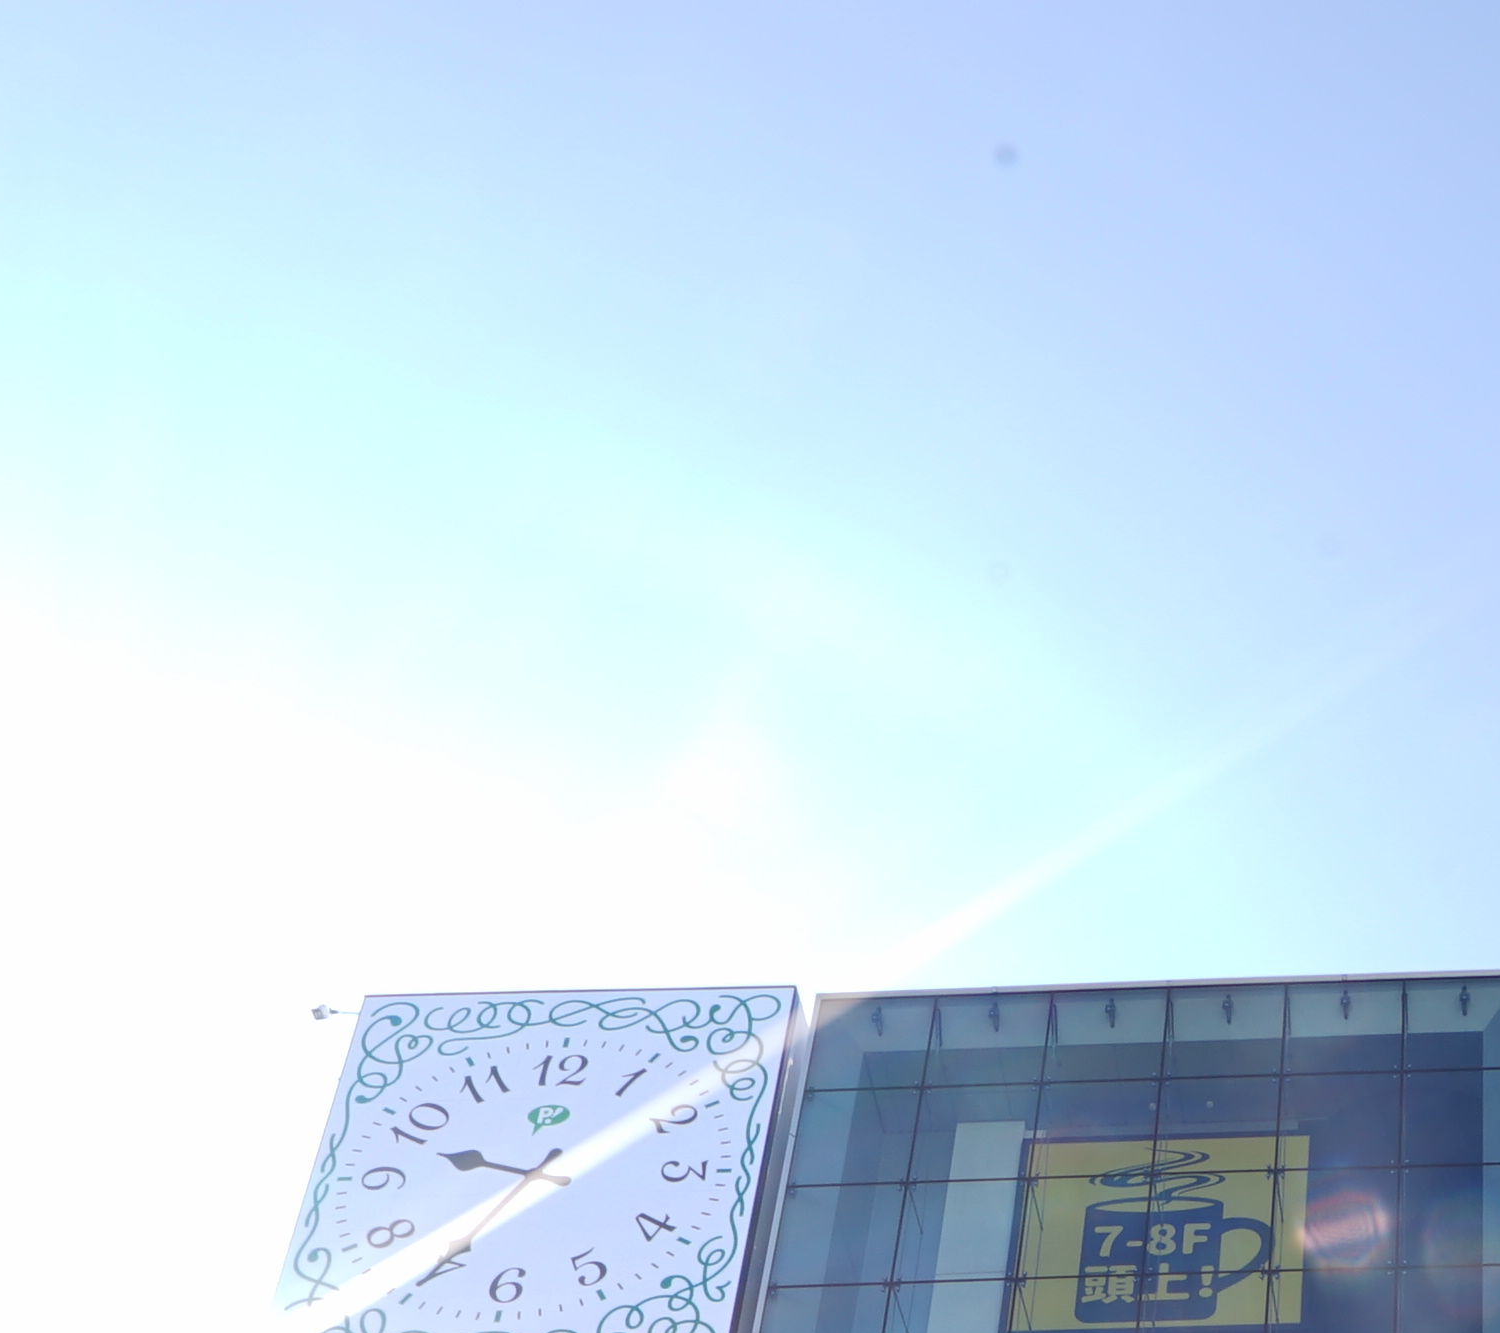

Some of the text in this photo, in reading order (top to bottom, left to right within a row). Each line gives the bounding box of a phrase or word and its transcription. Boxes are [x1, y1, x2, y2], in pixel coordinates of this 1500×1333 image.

[459, 1065, 511, 1103] 11
[532, 1054, 589, 1086] 12
[614, 1068, 648, 1098] 1
[391, 1102, 450, 1145] 10
[649, 1104, 698, 1134] 2
[361, 1167, 407, 1191] 9
[660, 1160, 709, 1182] 3
[366, 1219, 415, 1249] 8
[635, 1213, 676, 1242] 4
[1094, 1222, 1212, 1258] 7-8F
[570, 1247, 607, 1286] 5
[488, 1268, 526, 1303] 6
